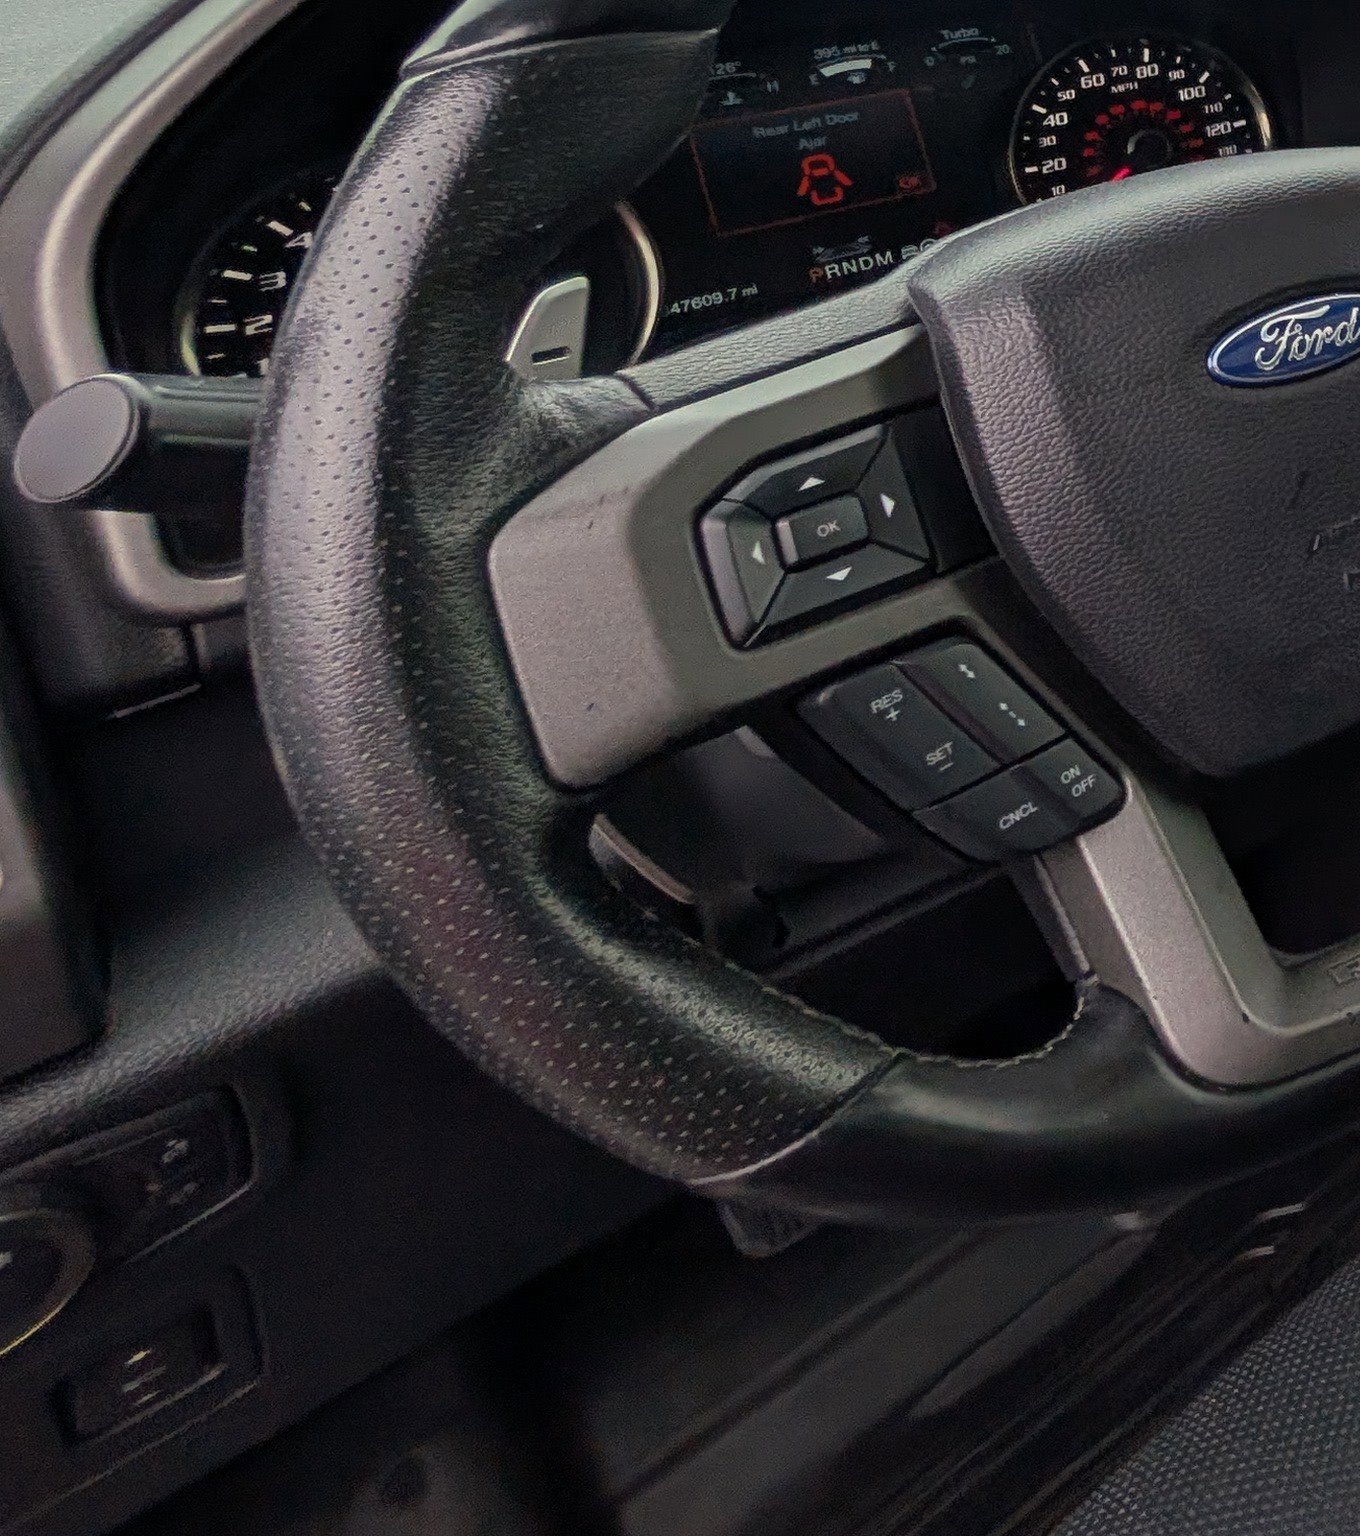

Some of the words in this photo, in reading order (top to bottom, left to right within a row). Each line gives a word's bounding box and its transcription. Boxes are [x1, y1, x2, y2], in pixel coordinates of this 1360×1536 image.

[1110, 64, 1129, 78] 70
[1135, 63, 1160, 80] 80
[1168, 68, 1186, 82] 90
[1080, 72, 1106, 90] 60
[1110, 81, 1139, 94] MPH
[1057, 88, 1076, 102] 50
[1178, 85, 1207, 102] 100
[1204, 101, 1223, 114] 110
[1042, 112, 1069, 128] 40
[1205, 121, 1232, 138] 120
[1038, 135, 1057, 148] 30
[1041, 157, 1068, 174] 20
[1051, 184, 1066, 197] 10
[258, 271, 287, 292] 3
[243, 314, 274, 336] 2
[816, 520, 841, 537] OK
[870, 689, 903, 712] RES
[926, 742, 954, 766] SET
[1061, 765, 1082, 784] ON
[1072, 776, 1097, 798] OFF
[999, 801, 1038, 830] CNCL
